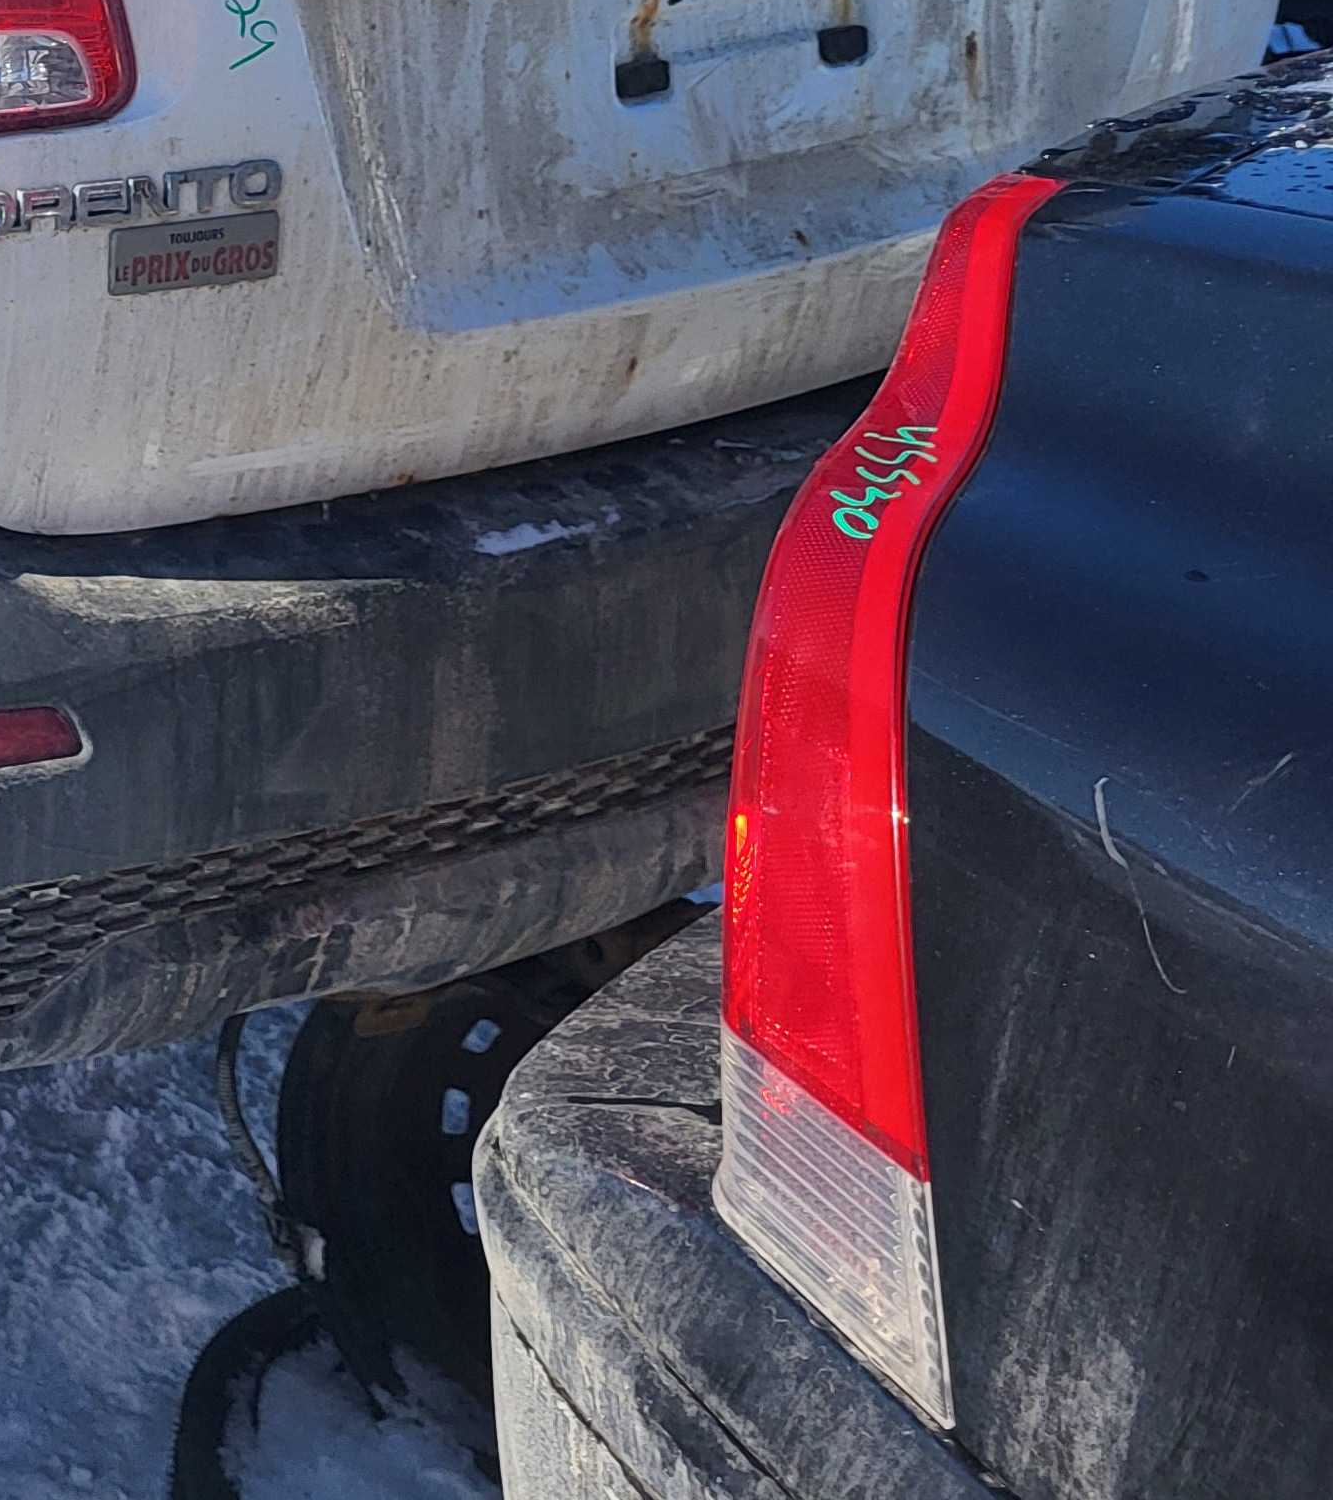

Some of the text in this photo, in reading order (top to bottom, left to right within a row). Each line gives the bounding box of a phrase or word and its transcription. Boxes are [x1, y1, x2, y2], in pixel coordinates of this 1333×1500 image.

[169, 228, 225, 245] TOUJOURS
[115, 240, 277, 286] LE PRIX DU GROS
